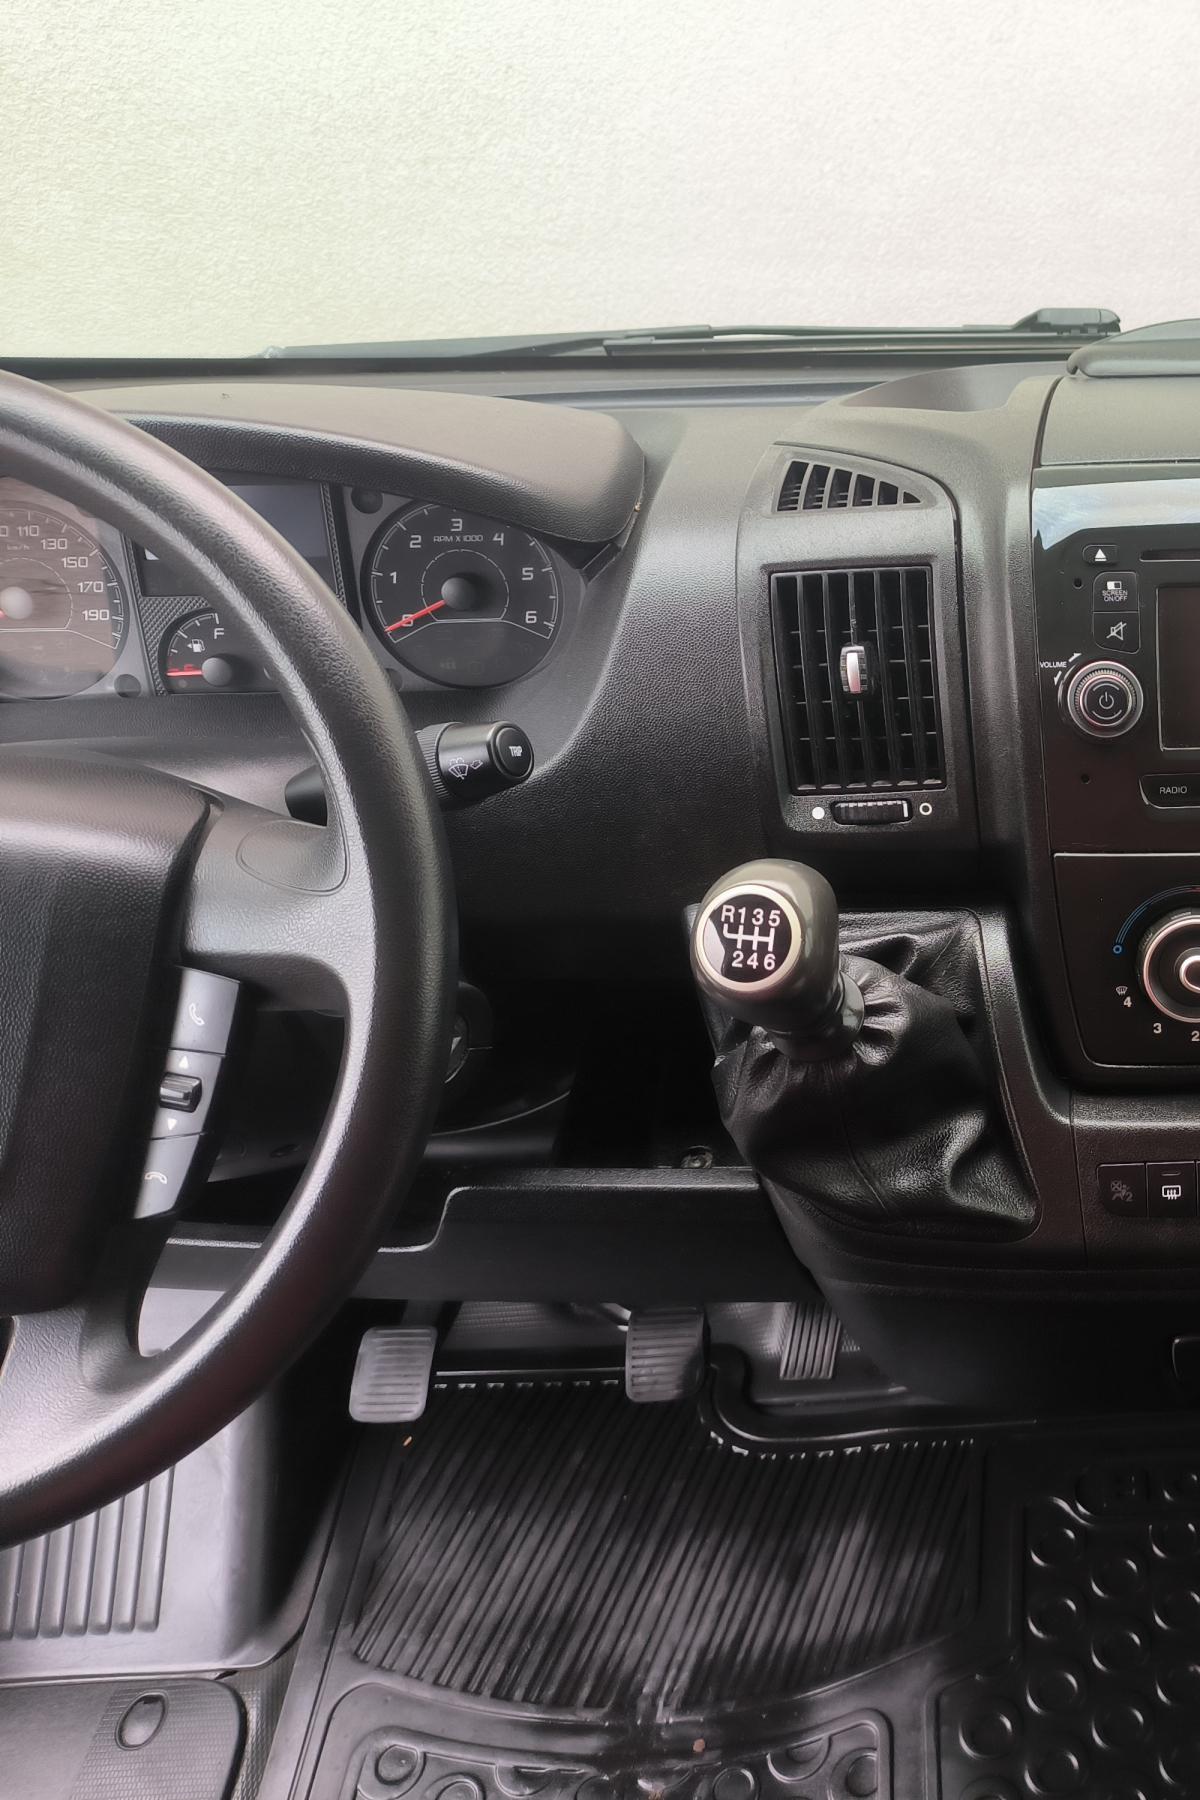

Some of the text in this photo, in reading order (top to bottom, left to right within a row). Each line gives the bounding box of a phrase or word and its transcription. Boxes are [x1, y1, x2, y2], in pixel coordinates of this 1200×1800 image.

[17, 525, 40, 537] 110
[451, 518, 463, 532] 3
[41, 538, 68, 550] 130
[409, 534, 422, 548] 2
[433, 534, 454, 543] RPM
[462, 534, 484, 543] 1000
[492, 532, 505, 546] 4
[61, 556, 89, 568] 150
[389, 571, 398, 584] 1
[521, 567, 534, 581] 5
[77, 581, 104, 593] 170
[1102, 589, 1129, 597] SCREEN
[82, 609, 110, 621] 190
[525, 610, 538, 624] 6
[213, 627, 225, 640] F
[508, 745, 523, 757] TRIP
[1159, 785, 1188, 795] RADIO
[1123, 996, 1132, 1008] 4
[1153, 1022, 1162, 1034] 3
[1191, 1030, 1200, 1042] 2
